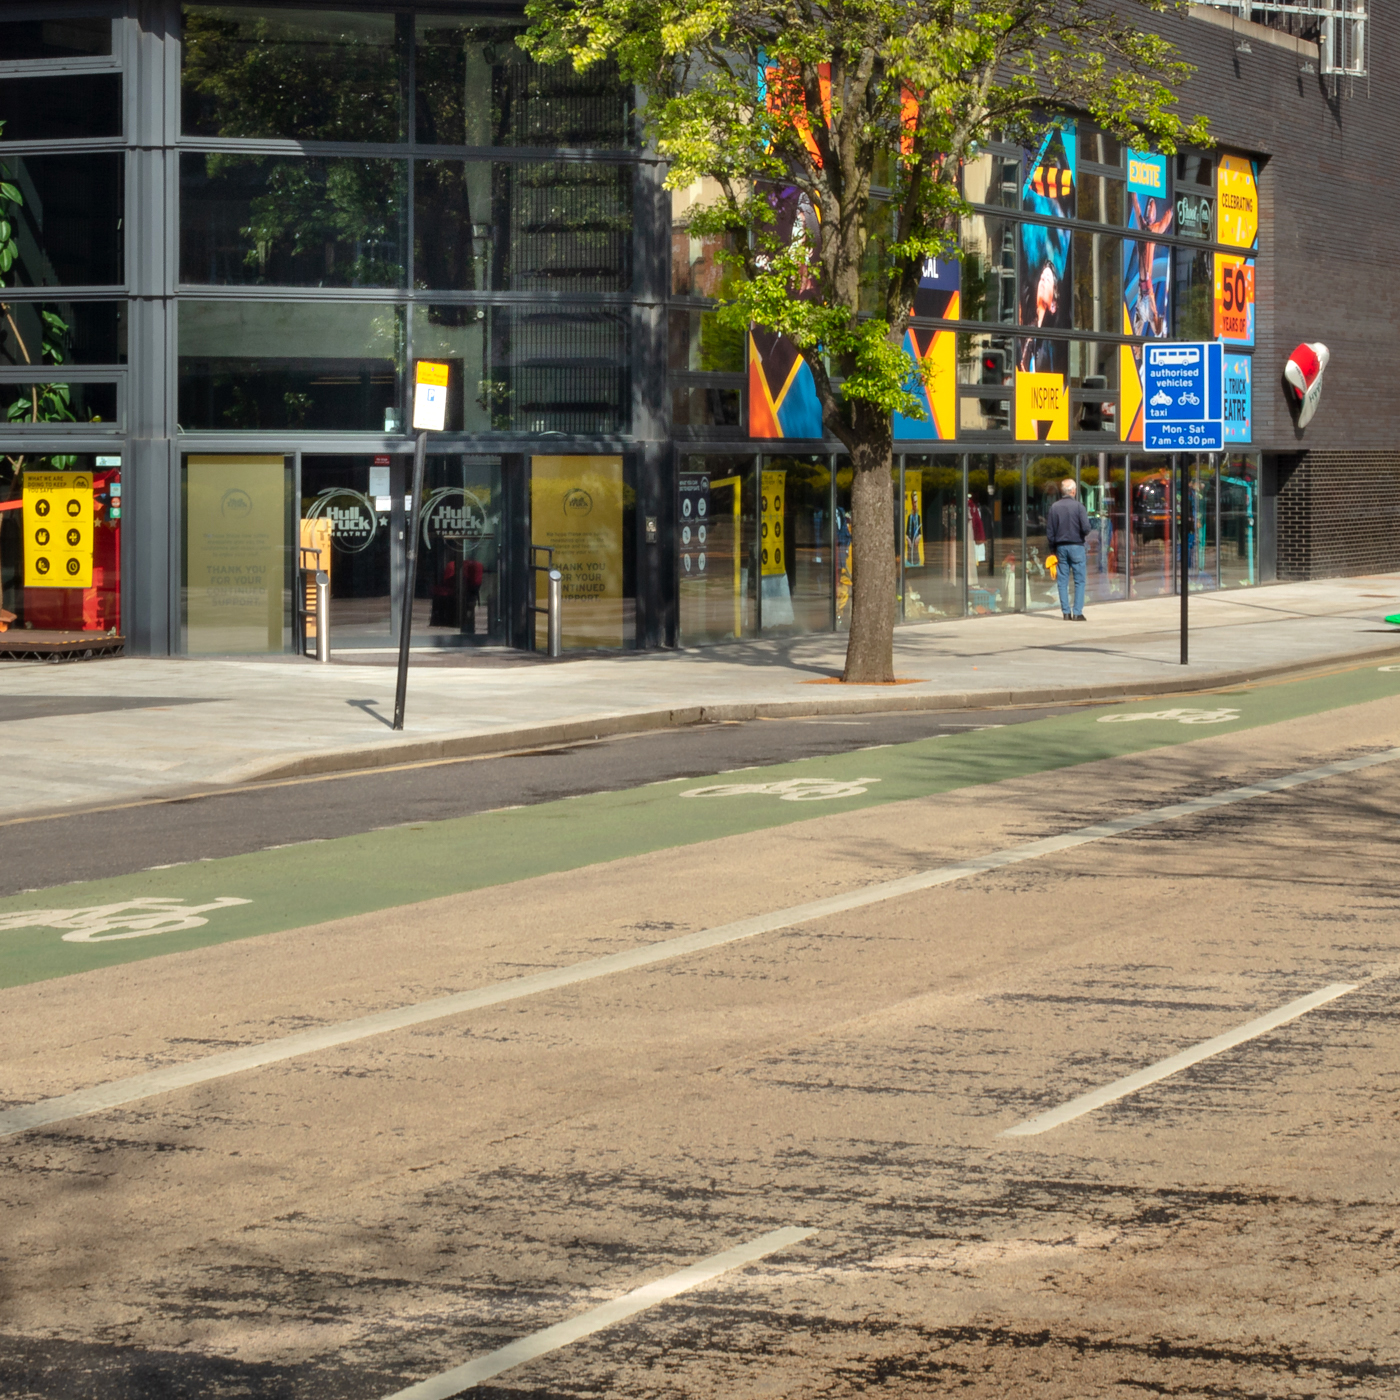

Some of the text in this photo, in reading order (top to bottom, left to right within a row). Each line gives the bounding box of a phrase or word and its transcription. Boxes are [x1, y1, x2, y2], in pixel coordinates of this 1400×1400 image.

[1129, 160, 1161, 188] EXCITE
[1221, 193, 1253, 213] CELEBRATING
[922, 257, 939, 279] CAL
[1222, 267, 1246, 312] 50
[1222, 316, 1246, 333] YEARS OF
[1150, 368, 1199, 378] authorised
[1156, 379, 1193, 388] vehicles
[1229, 378, 1247, 395] TRUCK
[1031, 387, 1059, 409] INSPIRE
[1150, 408, 1168, 417] taxi
[1224, 398, 1247, 421] EATRE
[1162, 425, 1182, 433] Mon
[1189, 425, 1205, 433] Sat
[326, 506, 360, 520] Hull
[439, 506, 471, 519] Hull
[431, 515, 482, 529] Truck
[207, 566, 266, 574] THANK YOU
[586, 563, 606, 571] YOU
[211, 576, 262, 584] FOR YOUR
[560, 573, 602, 581] OR YOUR
[561, 584, 606, 592] NTINUED
